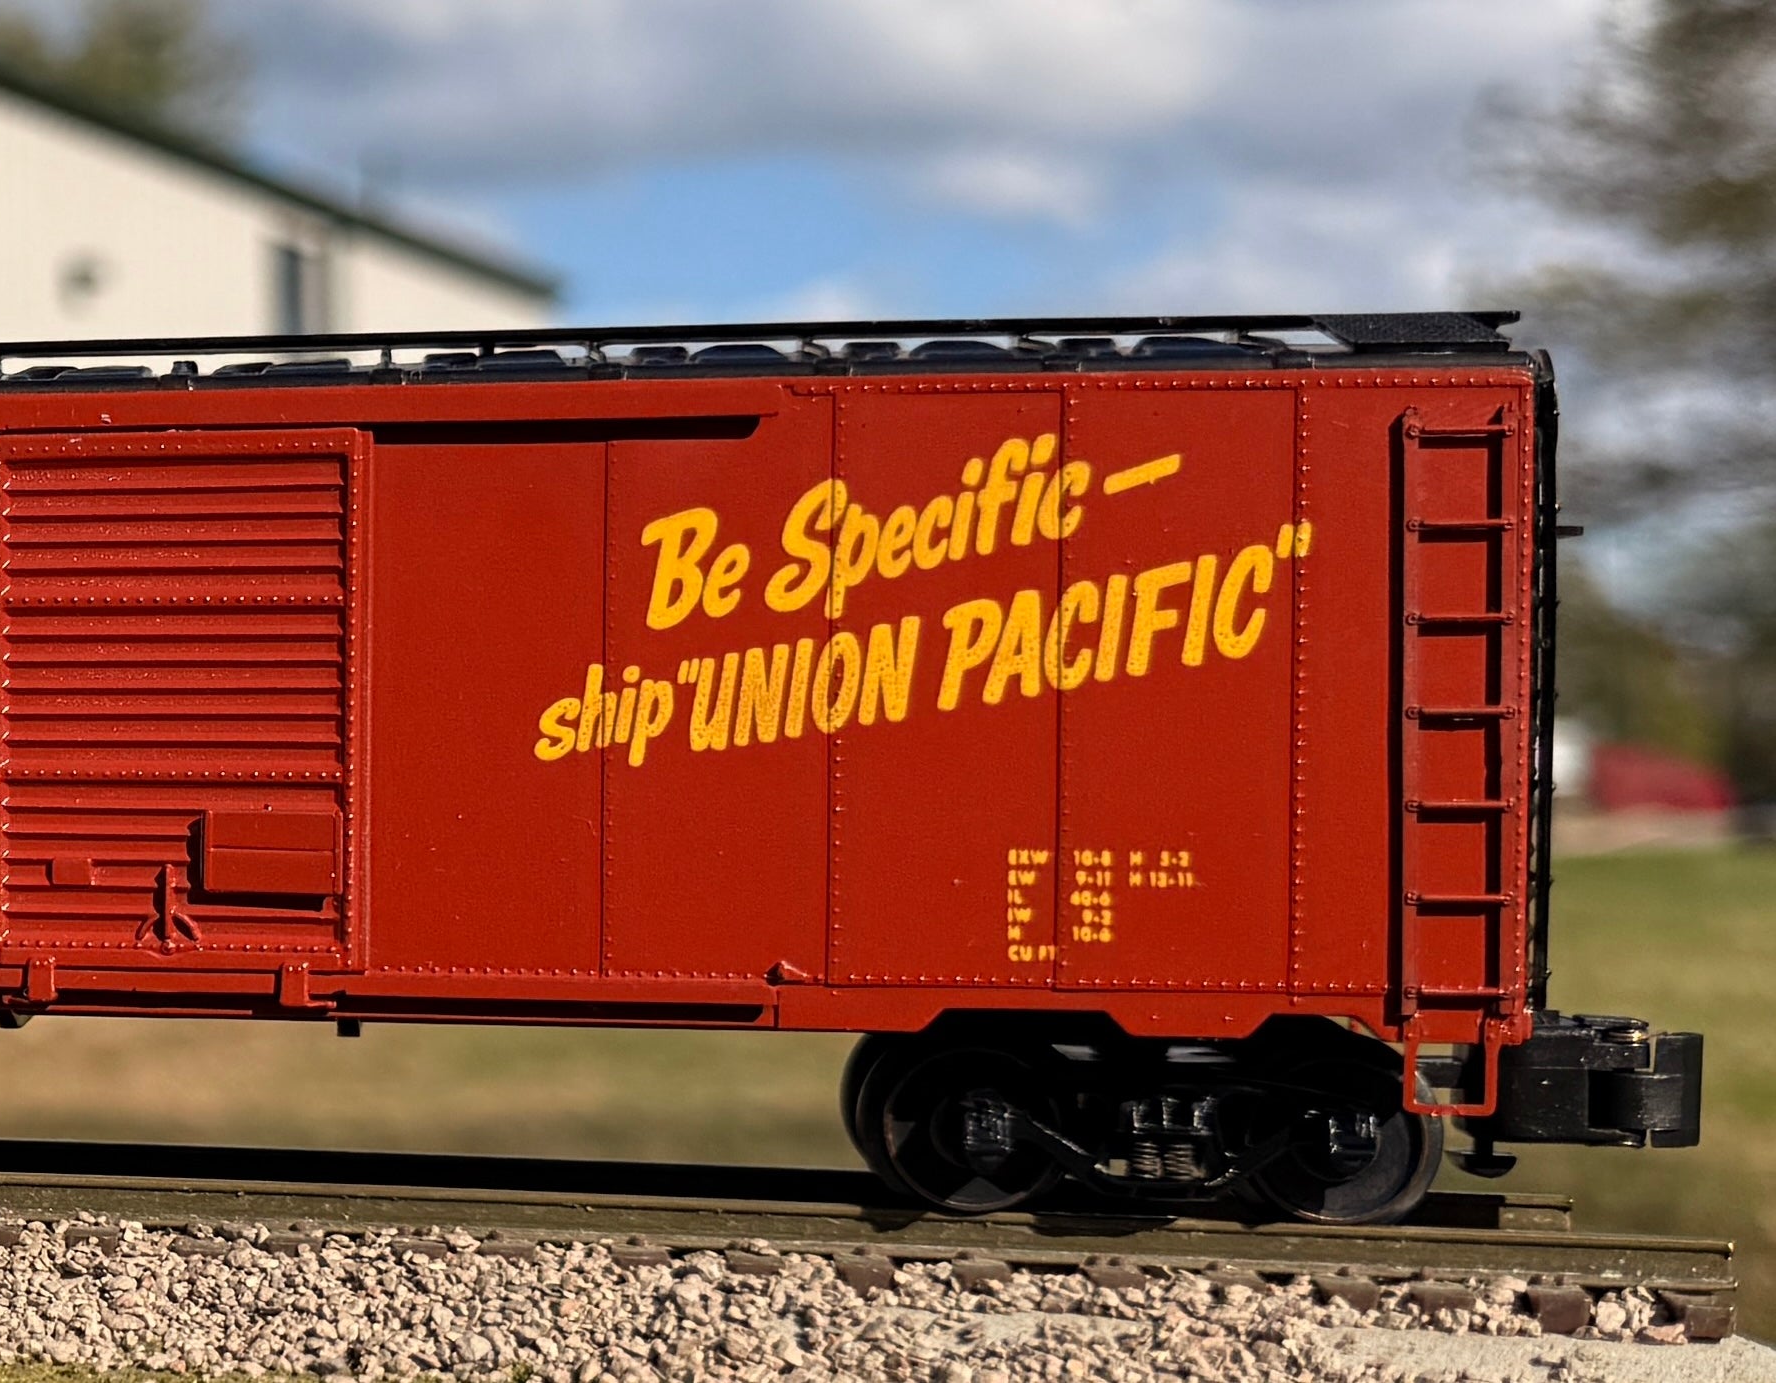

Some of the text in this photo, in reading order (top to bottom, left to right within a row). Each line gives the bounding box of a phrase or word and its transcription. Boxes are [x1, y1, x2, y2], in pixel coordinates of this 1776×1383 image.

[640, 506, 751, 630] Be
[764, 432, 1092, 620] Specific
[533, 519, 1313, 767] ship "UNION PACIFIC"
